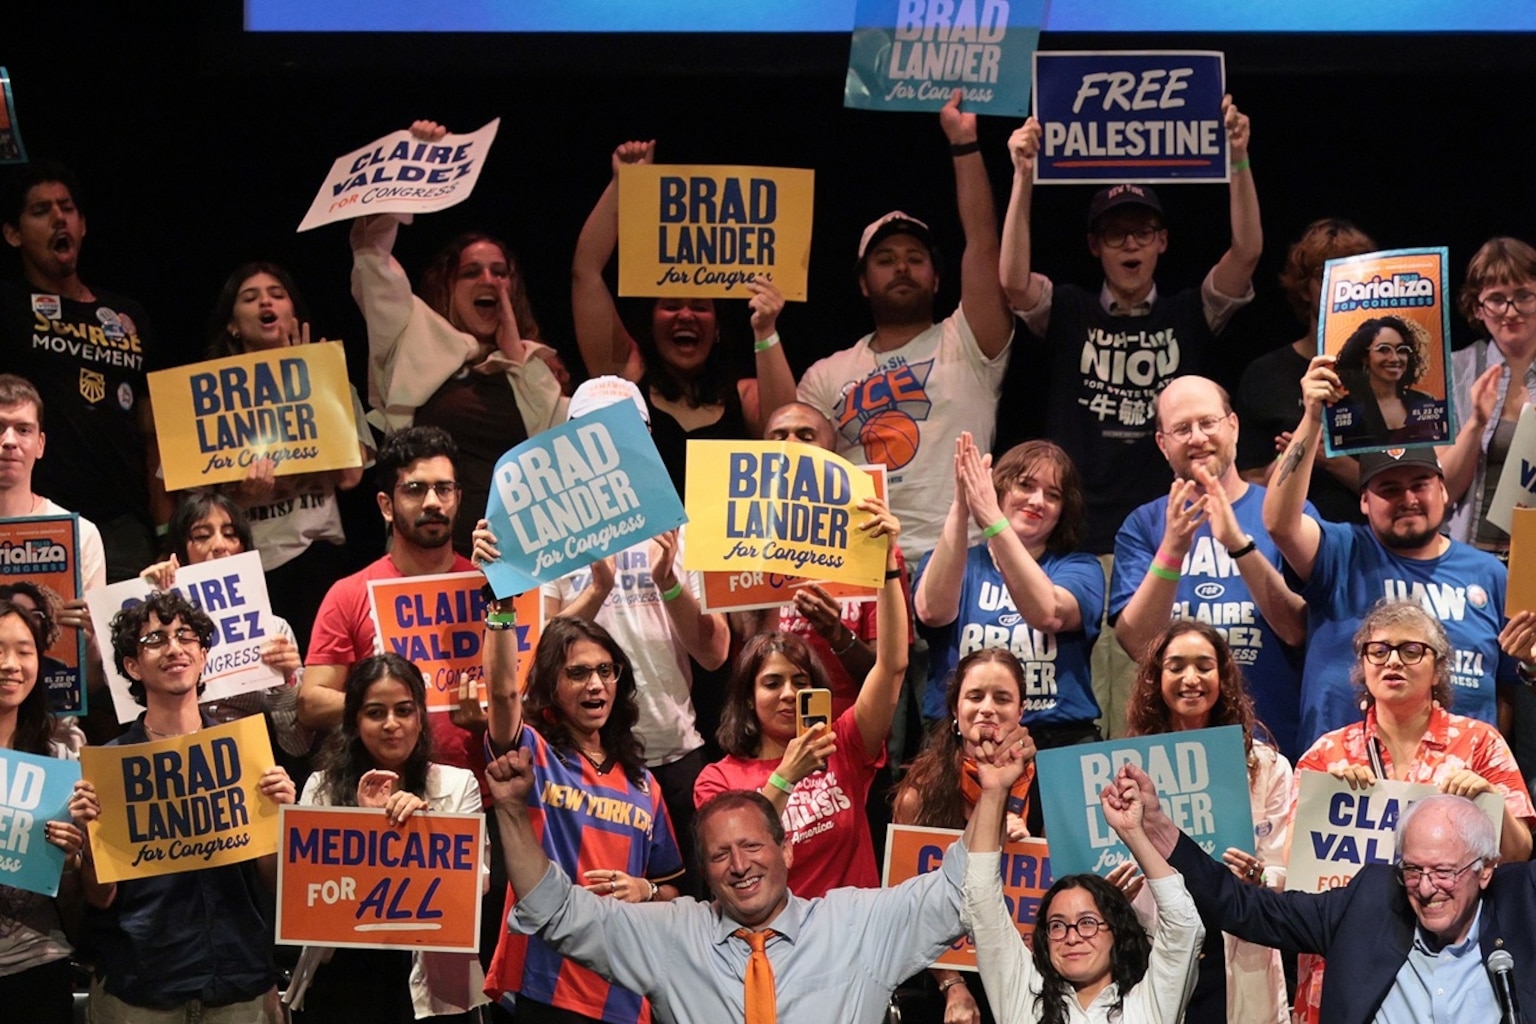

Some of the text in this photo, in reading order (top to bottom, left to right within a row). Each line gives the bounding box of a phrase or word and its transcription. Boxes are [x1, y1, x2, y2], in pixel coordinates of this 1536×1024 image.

[889, 43, 1001, 83] LANDER
[885, 81, 915, 102] for
[1072, 68, 1194, 113] FREE
[350, 141, 475, 174] CLAIRE
[1044, 120, 1219, 157] PALESTINE
[328, 181, 459, 213] FOR CONGRESS
[333, 159, 475, 197] VALDEZ
[659, 176, 777, 224] BRAD
[658, 225, 776, 266] LANDER
[656, 267, 691, 286] for
[1334, 274, 1433, 303] Darializa
[1334, 297, 1433, 311] FOR CONGRESS
[32, 334, 143, 371] MOVEMENT
[1080, 338, 1180, 387] NIOU
[190, 358, 312, 417] BRAD
[839, 364, 928, 428] ICE
[195, 403, 318, 454] LANDER
[202, 445, 319, 475] for Congress
[495, 422, 620, 516] BRAD
[728, 452, 852, 506] BRAD
[509, 467, 640, 554] LANDER
[727, 501, 849, 549] LANDER
[531, 512, 646, 577] for Congress
[724, 541, 845, 569] for Congress
[394, 589, 486, 629] CLAIR
[122, 736, 242, 804] BRAD
[127, 785, 249, 843] LANDER
[542, 781, 634, 825] NEW YORK
[782, 786, 851, 832] IALISTS
[132, 832, 250, 867] for Congress
[289, 827, 474, 871] MEDICARE
[307, 876, 443, 920] FOR ALL
